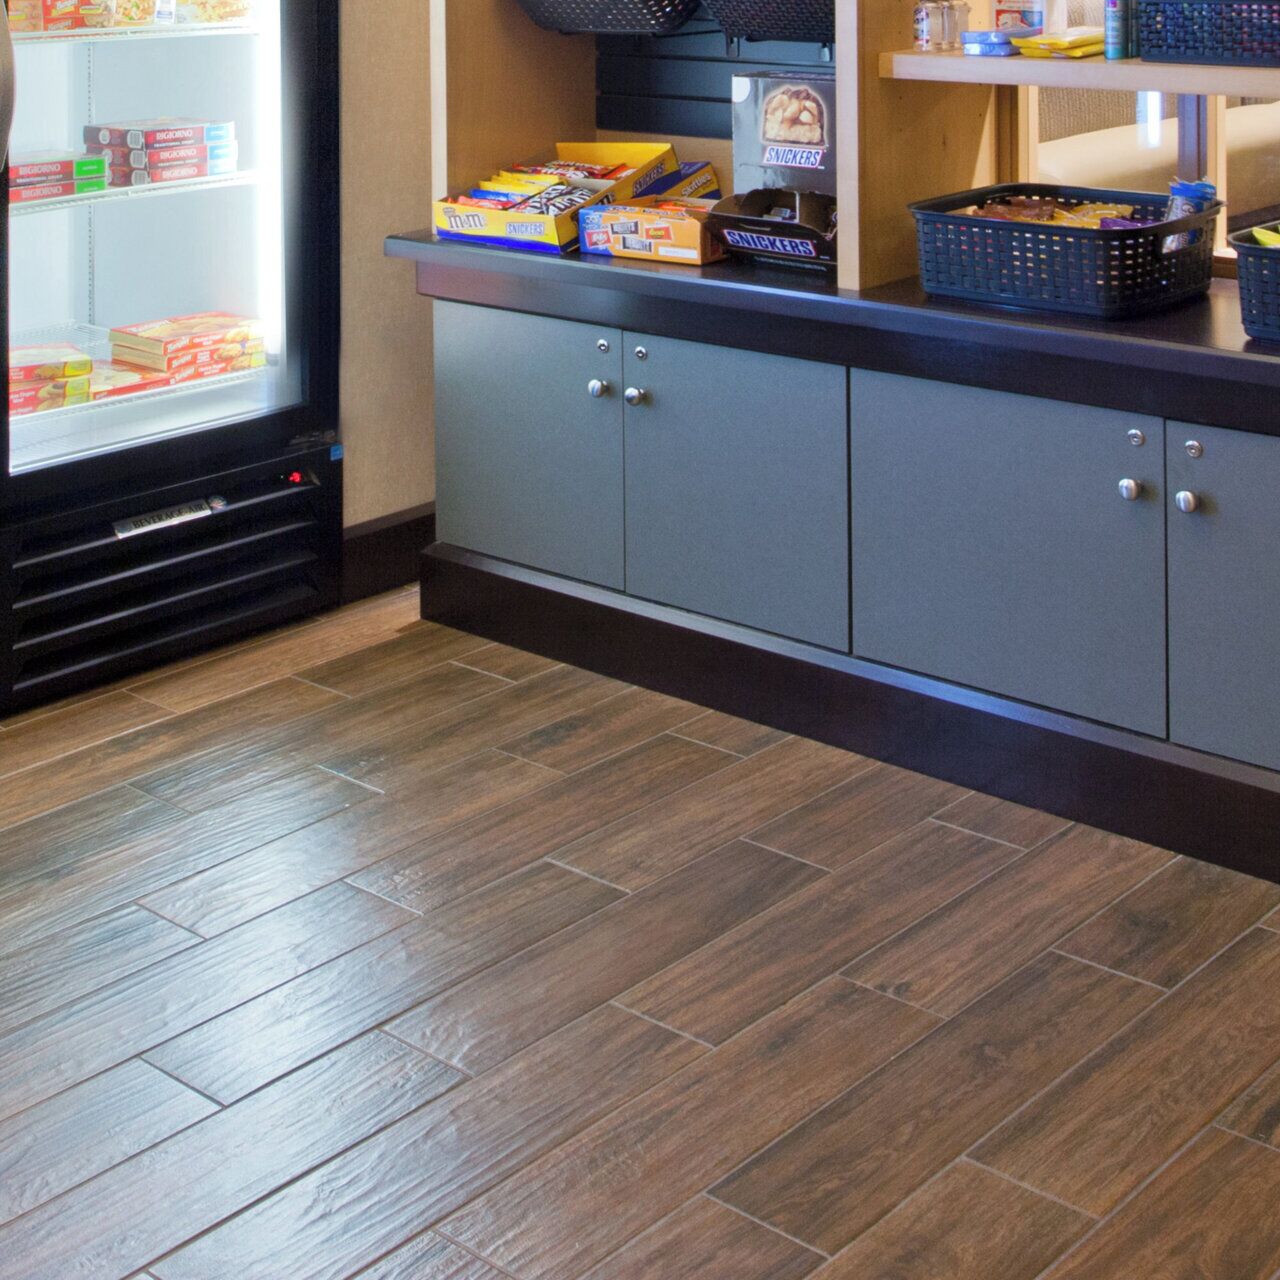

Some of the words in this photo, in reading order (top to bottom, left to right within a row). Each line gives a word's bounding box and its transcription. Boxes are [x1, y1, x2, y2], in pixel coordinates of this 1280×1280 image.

[766, 147, 821, 167] SNICKERS
[507, 223, 544, 235] SNICKERS
[726, 230, 816, 257] SNICKERS
